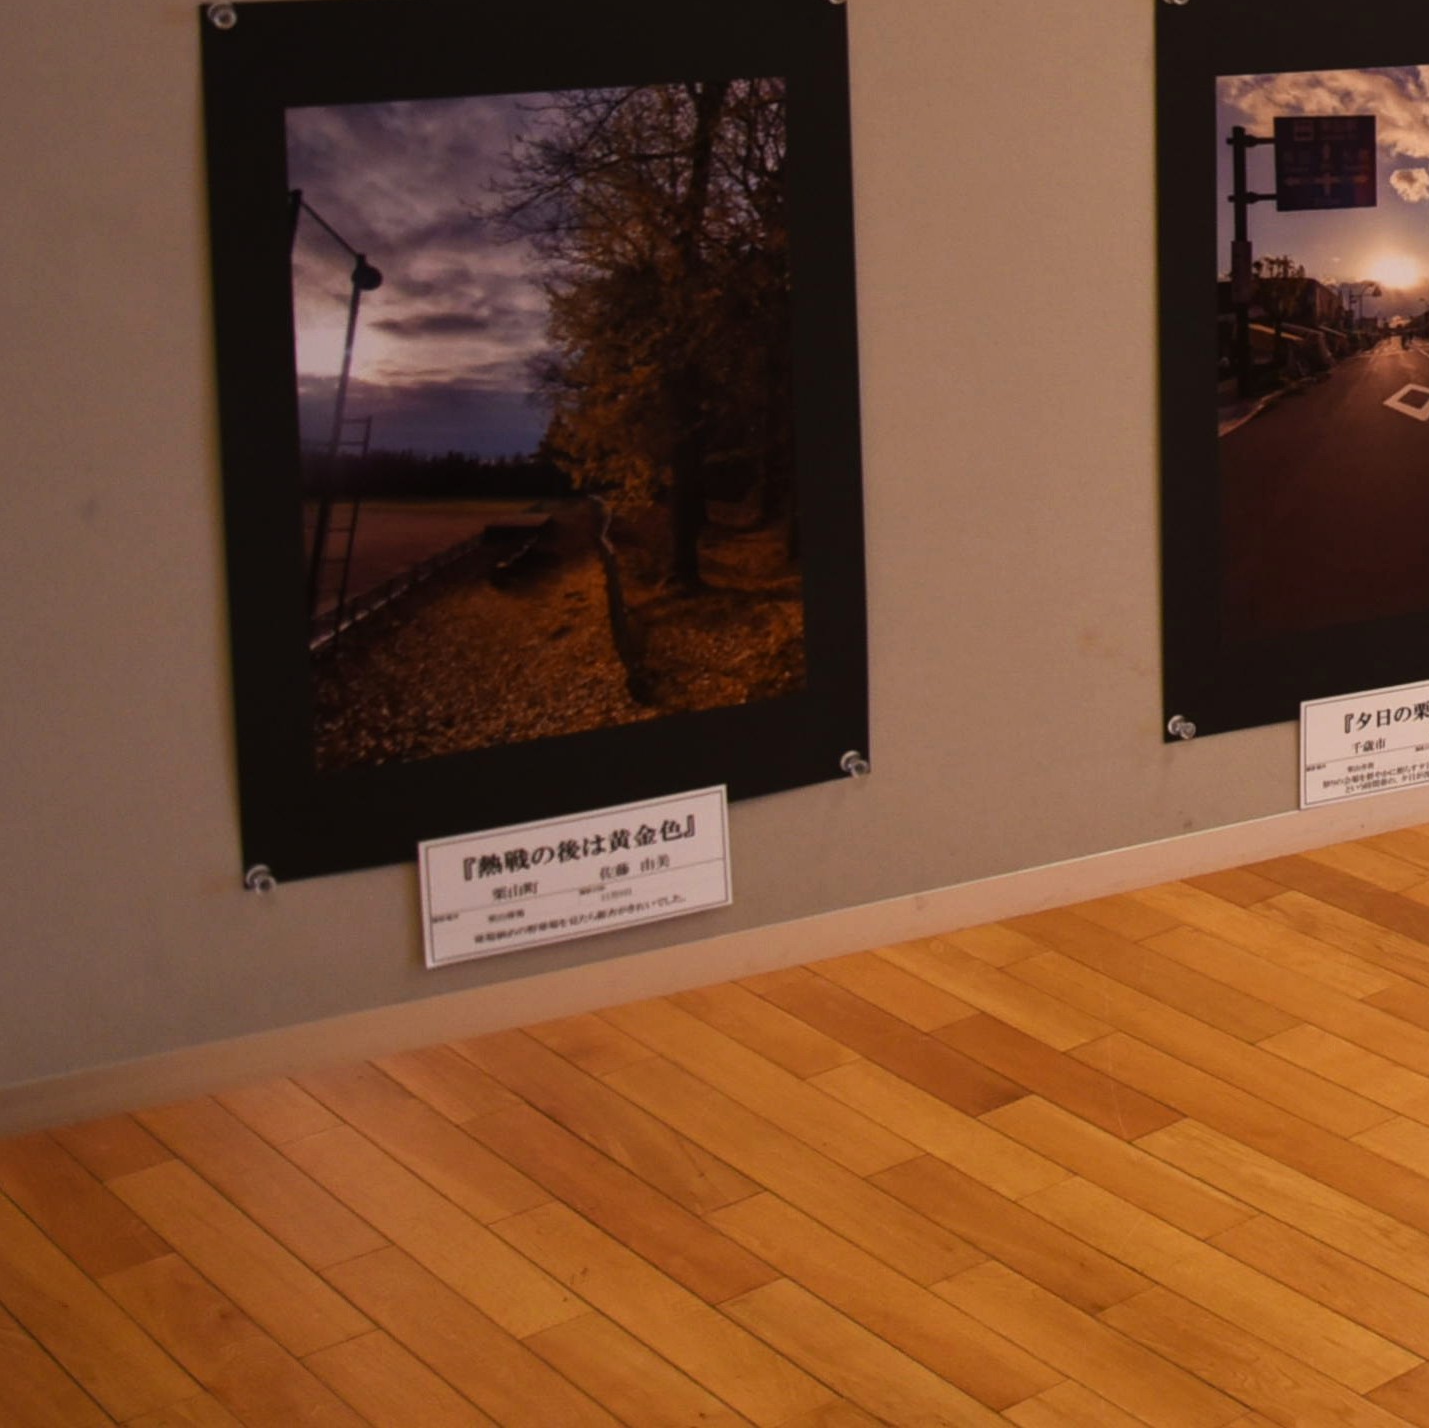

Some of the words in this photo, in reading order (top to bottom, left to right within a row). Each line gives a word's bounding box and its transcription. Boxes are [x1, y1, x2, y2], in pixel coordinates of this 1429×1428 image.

[1351, 737, 1386, 754] 千歳市
[463, 814, 697, 881] 『熱戦の後は黄金色』
